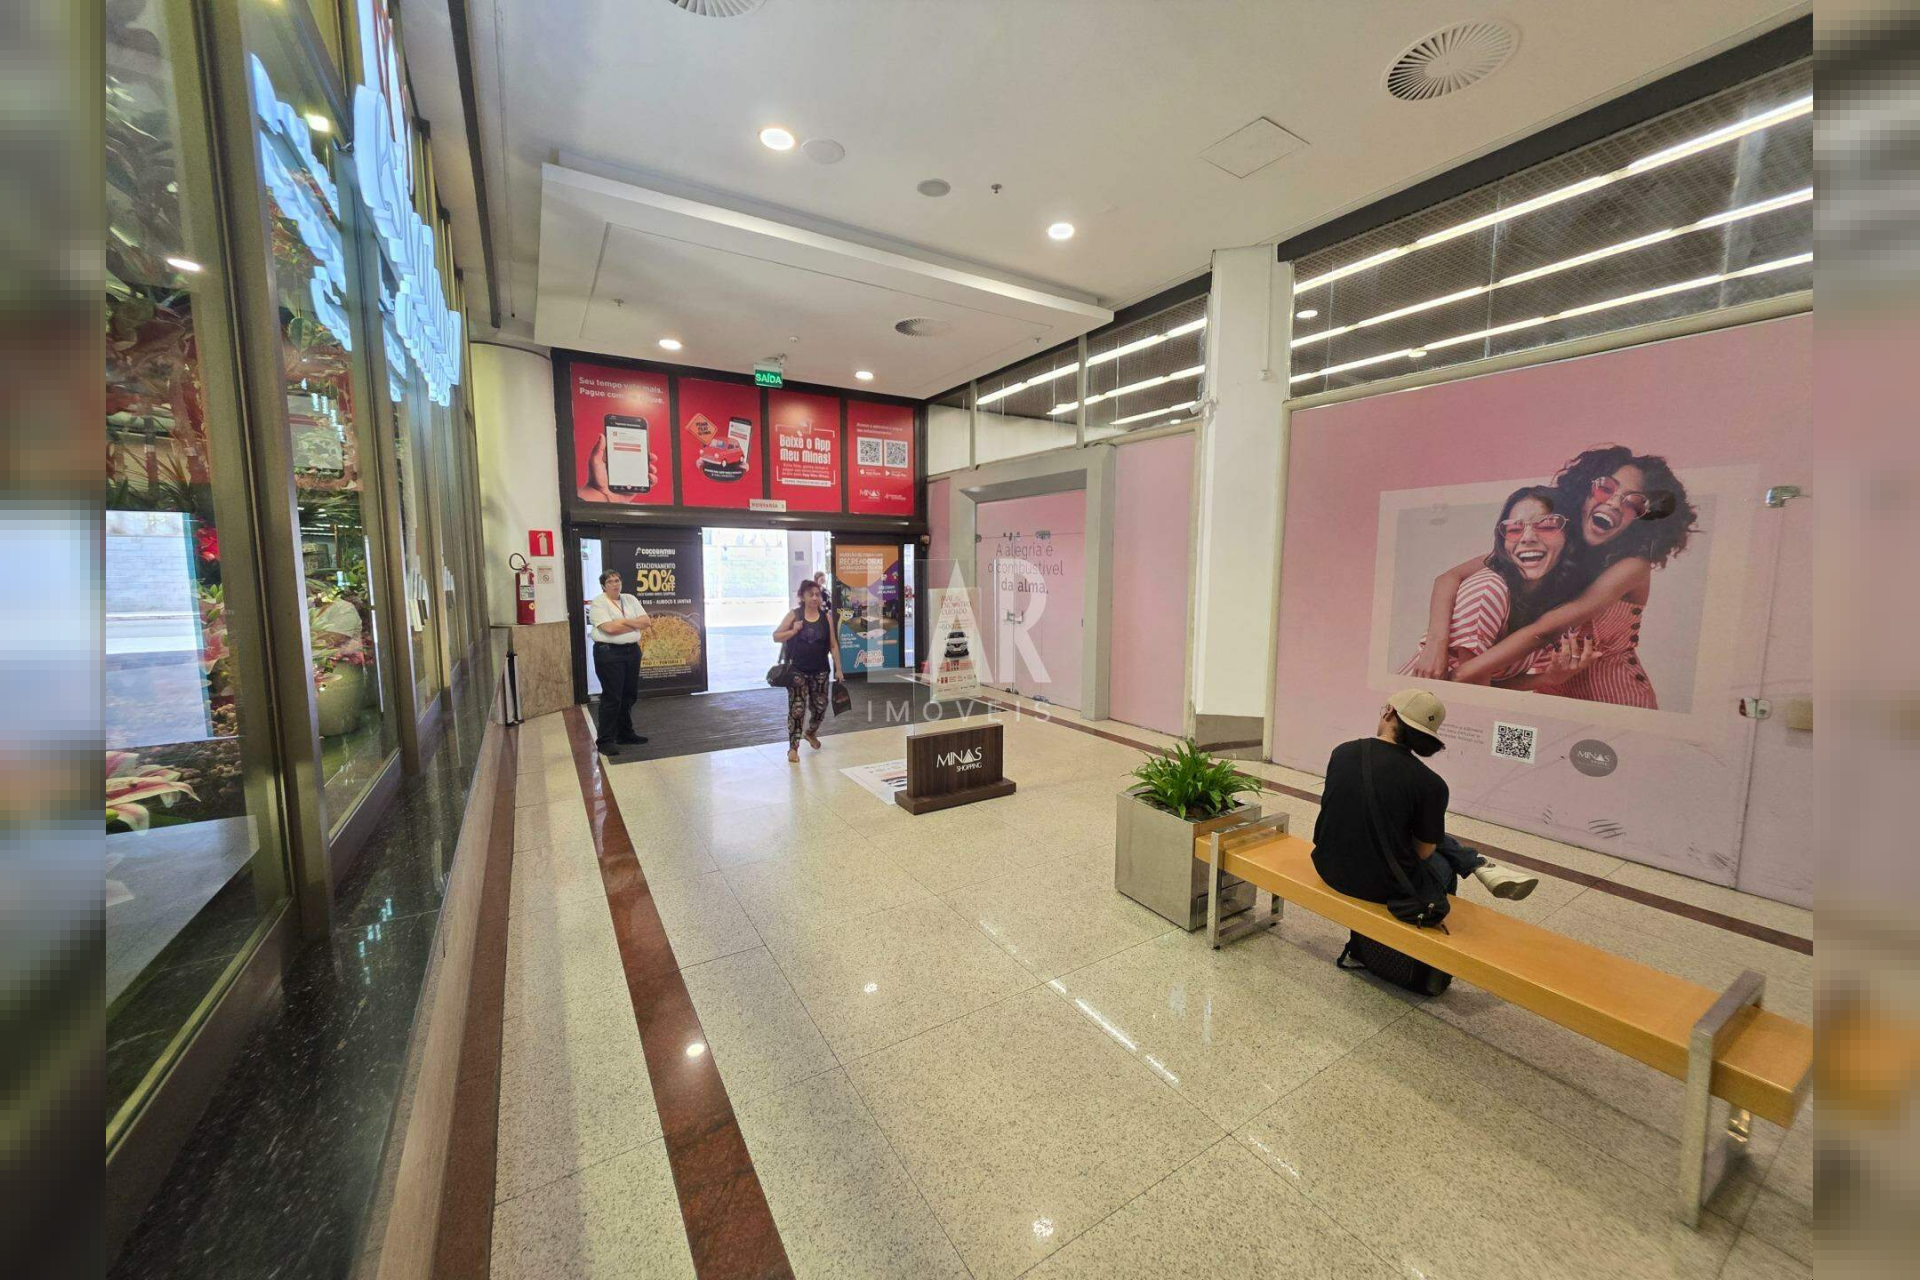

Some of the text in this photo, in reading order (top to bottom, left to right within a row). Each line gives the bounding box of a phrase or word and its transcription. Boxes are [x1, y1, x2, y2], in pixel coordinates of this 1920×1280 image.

[579, 376, 595, 385] Seu
[597, 379, 622, 389] tempo
[755, 373, 783, 384] SAÍDA
[579, 387, 605, 397] Pague
[806, 438, 812, 450] o
[815, 437, 831, 452] App
[780, 448, 831, 465] Meu Minas!
[996, 542, 1054, 561] A alegria é
[636, 569, 676, 592] 50%
[661, 582, 676, 592] OFF
[1001, 578, 1050, 594] da alma.
[936, 746, 983, 768] MINAS
[1577, 750, 1610, 762] MINAS
